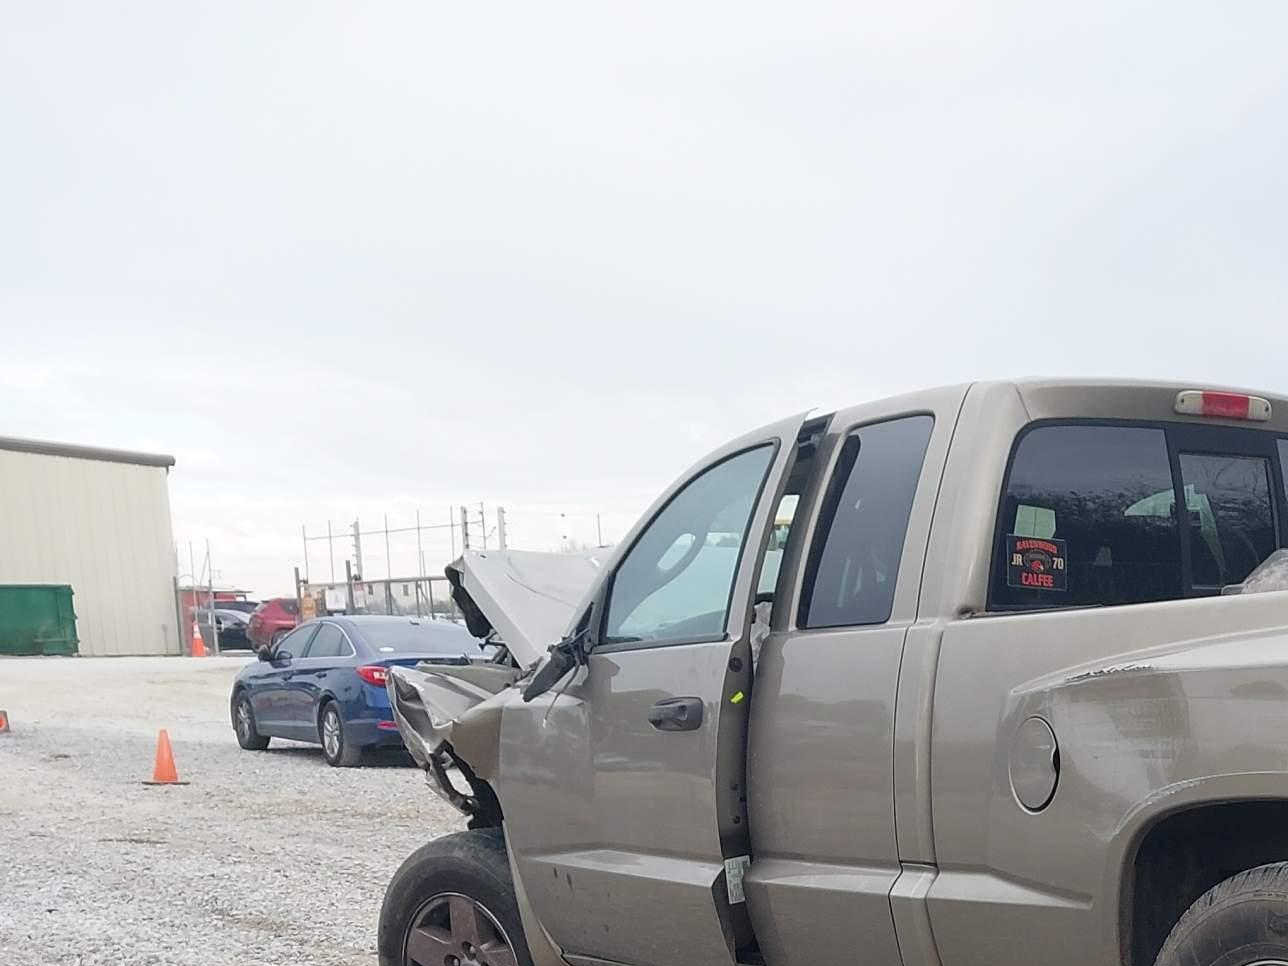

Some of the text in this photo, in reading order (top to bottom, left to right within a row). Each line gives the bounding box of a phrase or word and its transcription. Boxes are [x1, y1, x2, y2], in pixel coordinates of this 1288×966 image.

[1011, 553, 1064, 570] JR 70
[1021, 572, 1054, 587] CALFEE
